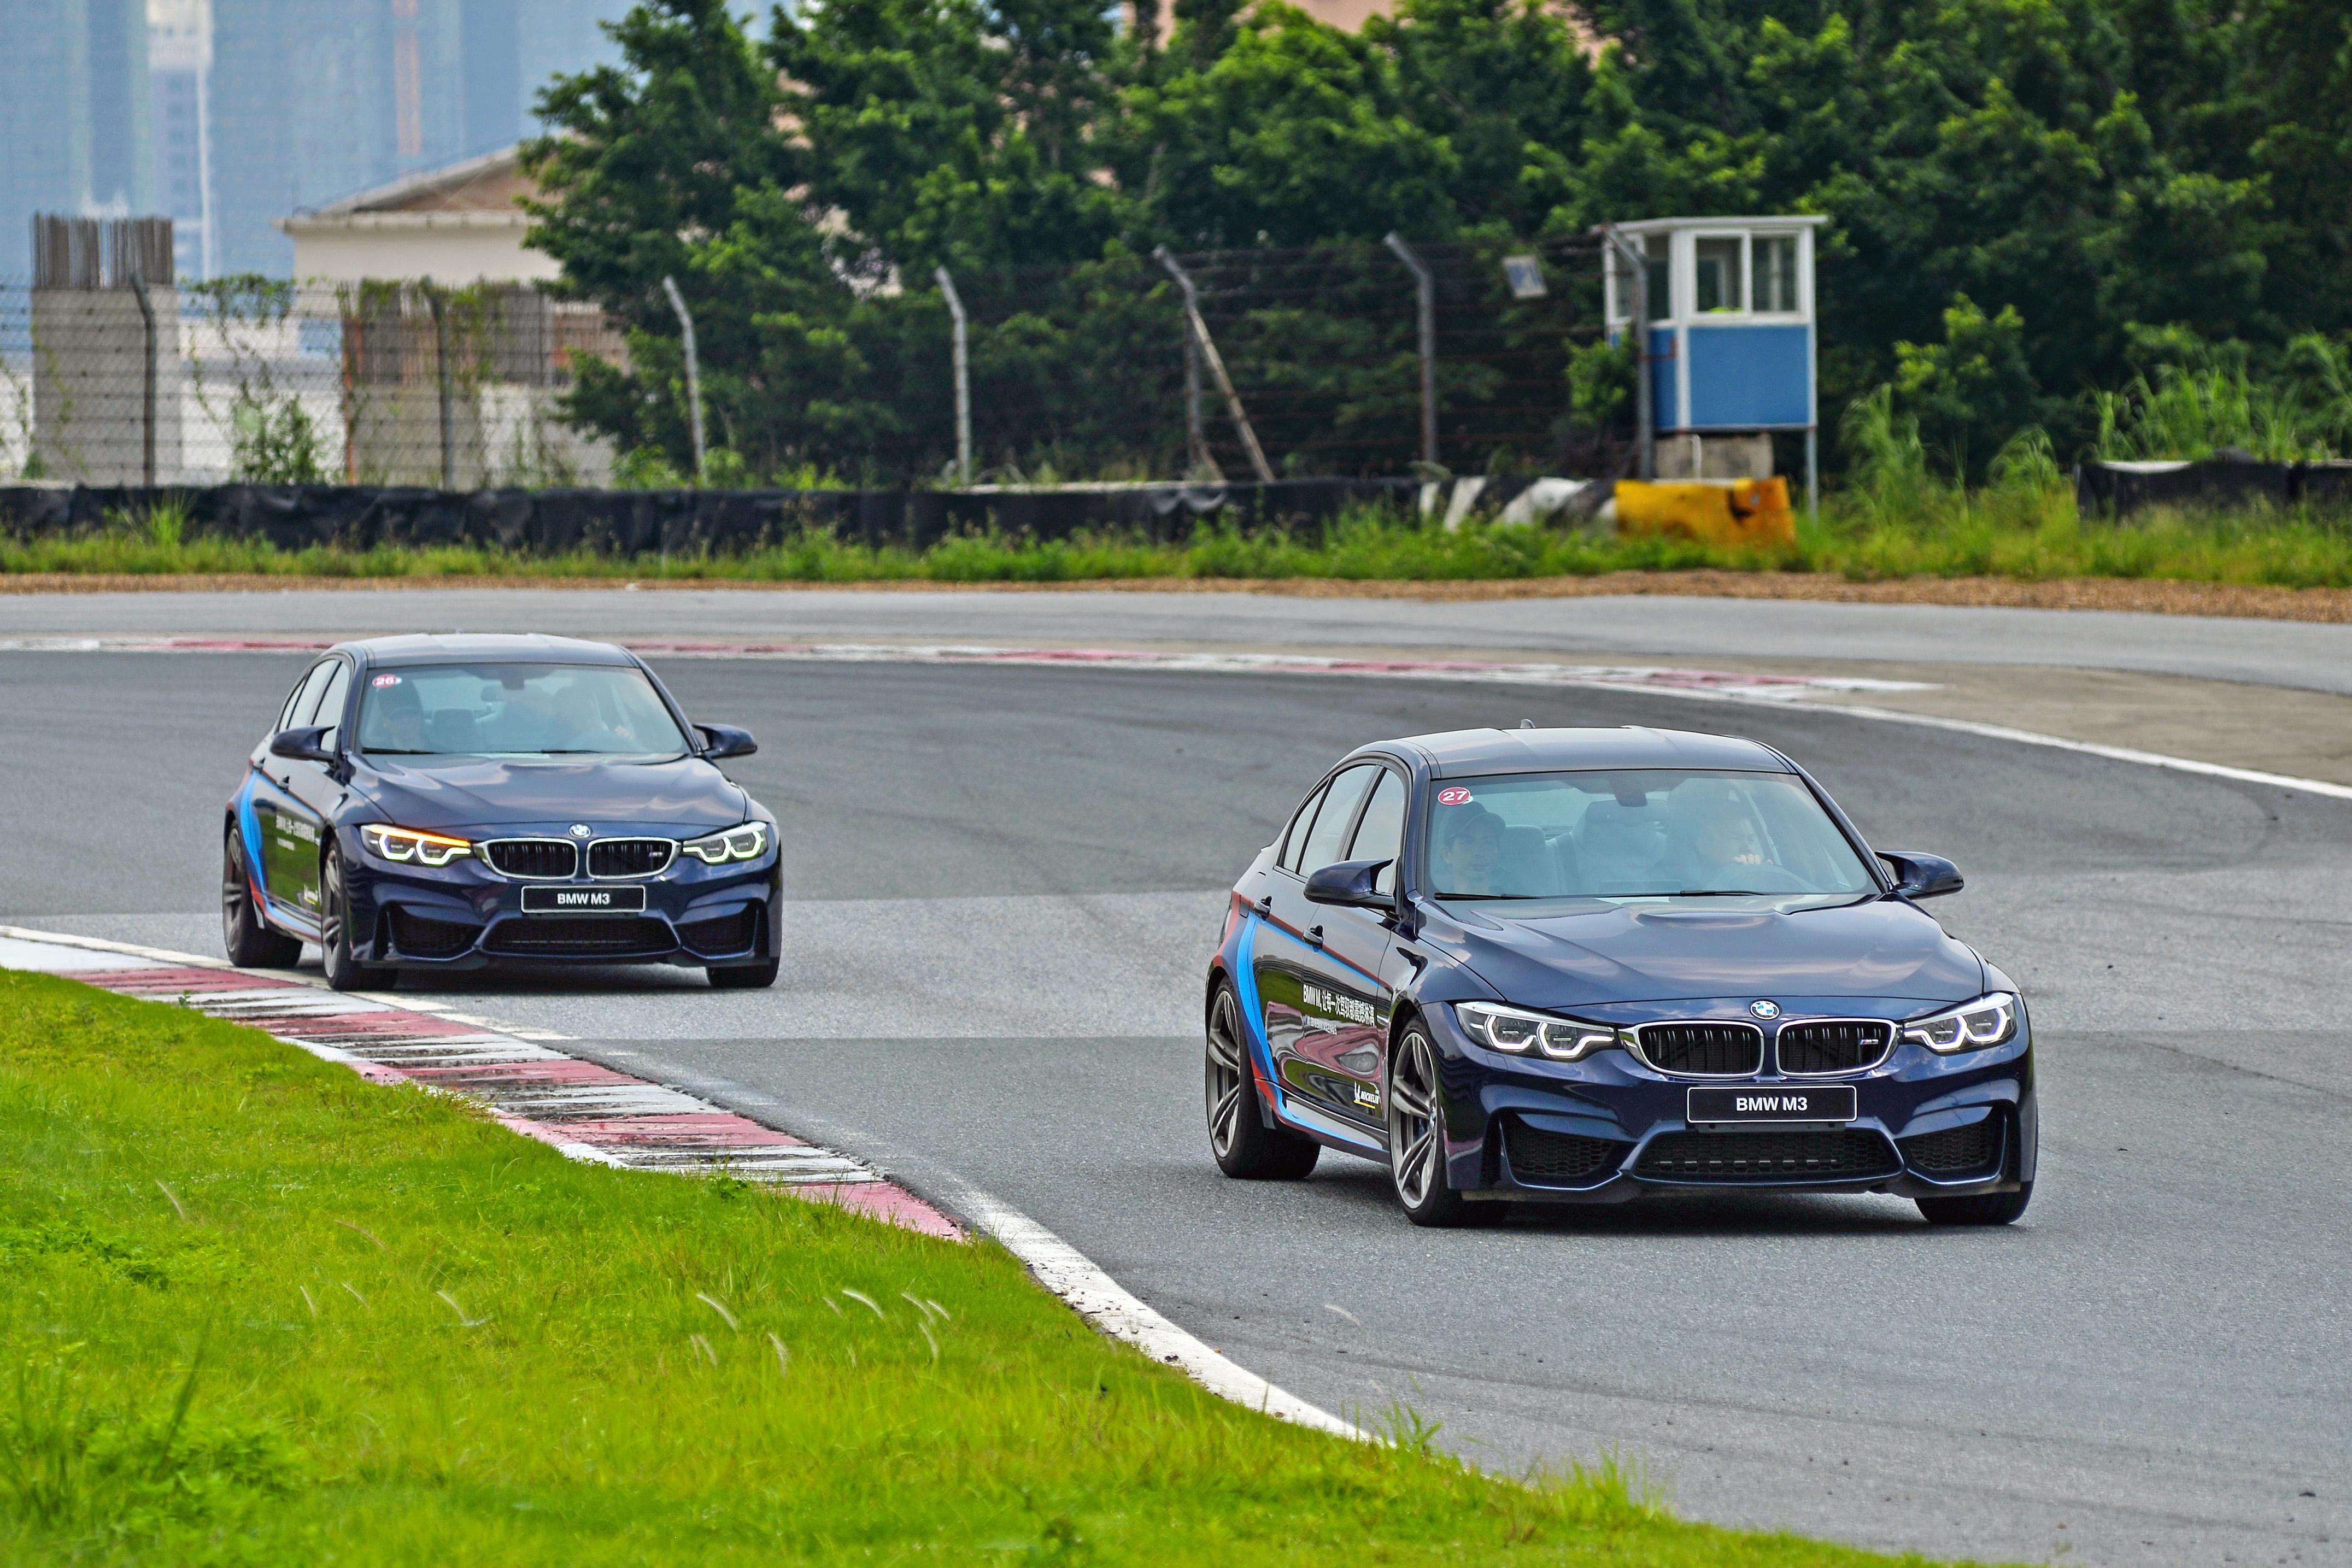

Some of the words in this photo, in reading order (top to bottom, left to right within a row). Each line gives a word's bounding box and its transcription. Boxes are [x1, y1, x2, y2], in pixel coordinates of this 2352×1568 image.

[376, 677, 394, 686] 26
[1442, 791, 1468, 801] 27
[558, 892, 589, 905] BMW
[590, 892, 611, 905] M3
[1303, 984, 1316, 1006] BMW
[1736, 1096, 1779, 1111] BMW
[1782, 1096, 1808, 1111] M3
